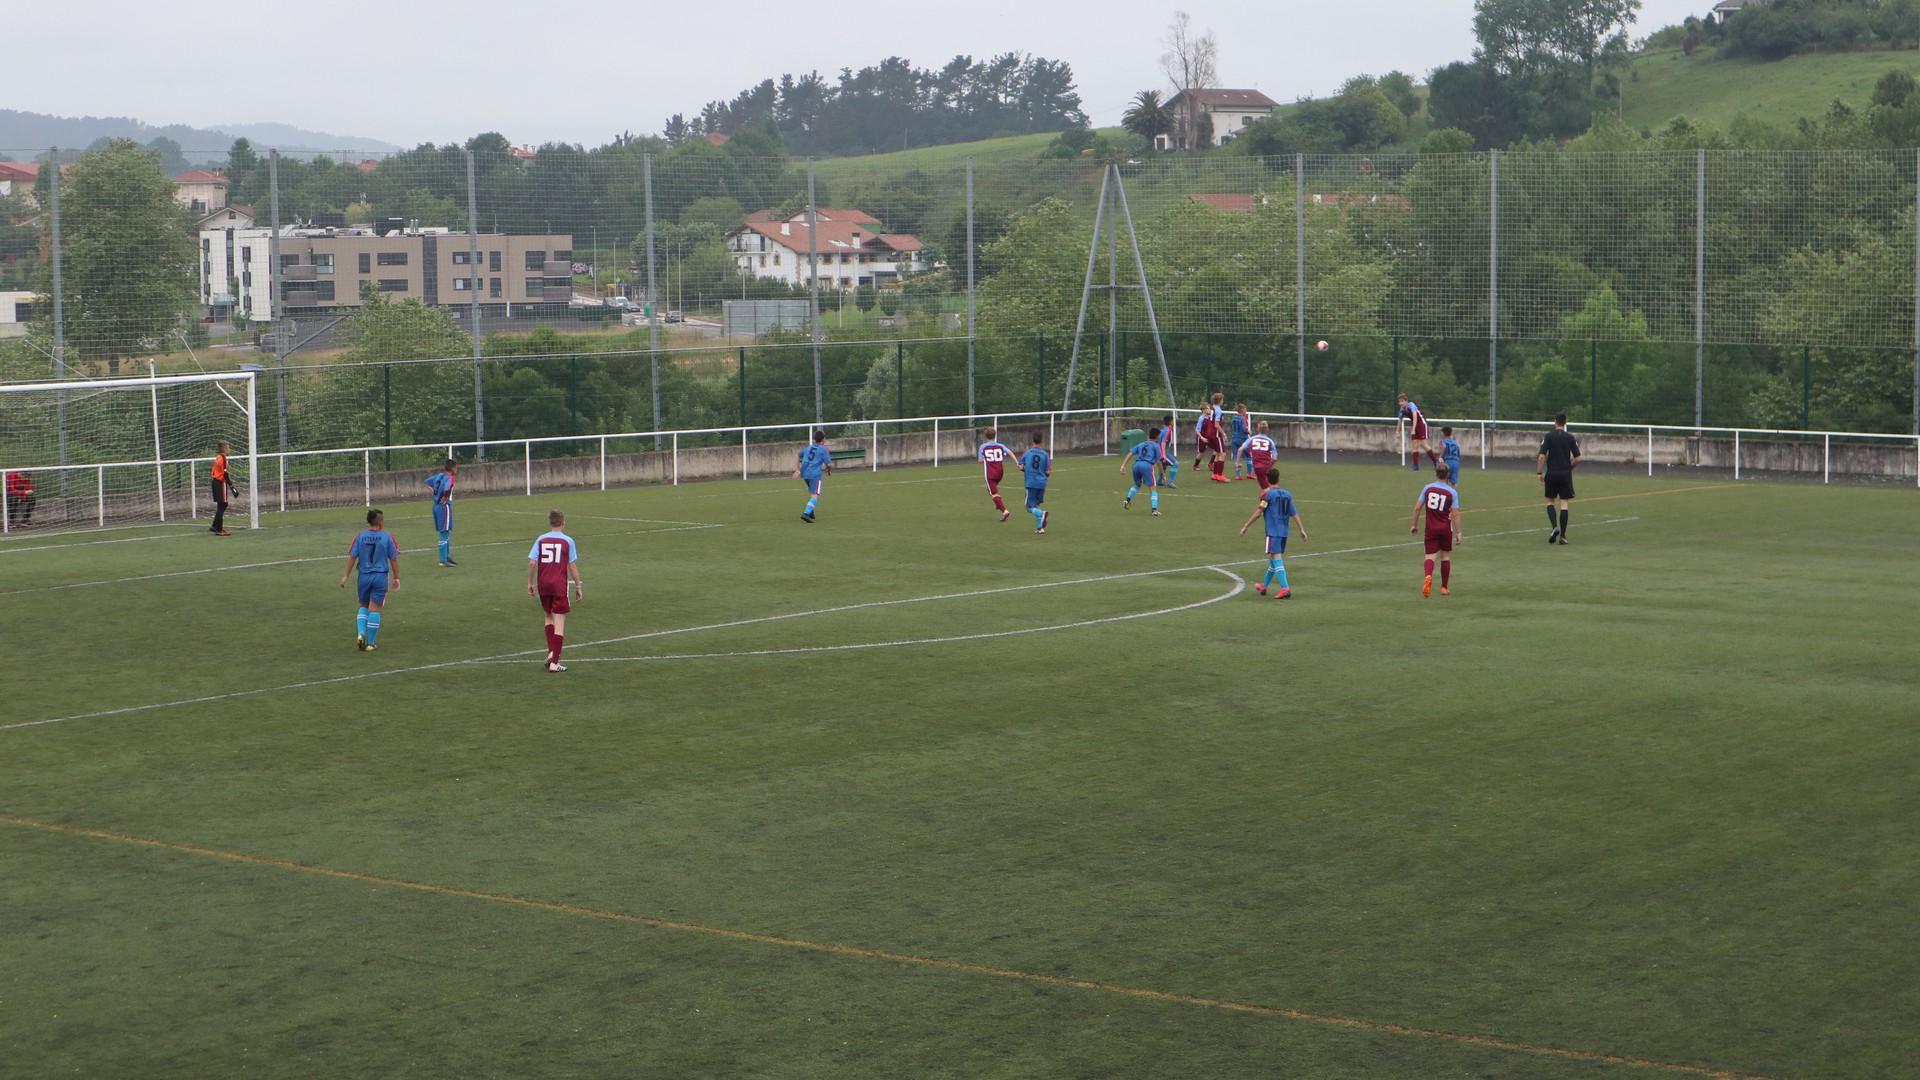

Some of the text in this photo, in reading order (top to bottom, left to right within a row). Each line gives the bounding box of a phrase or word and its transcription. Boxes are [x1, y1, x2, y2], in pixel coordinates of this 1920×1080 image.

[1252, 438, 1270, 452] 53
[1446, 442, 1458, 457] 12
[808, 446, 818, 461] 5
[984, 448, 1004, 462] 50
[1032, 454, 1041, 470] 8
[1275, 496, 1290, 515] 10
[1427, 491, 1447, 512] 81
[364, 543, 376, 564] 7
[541, 543, 562, 564] 51
